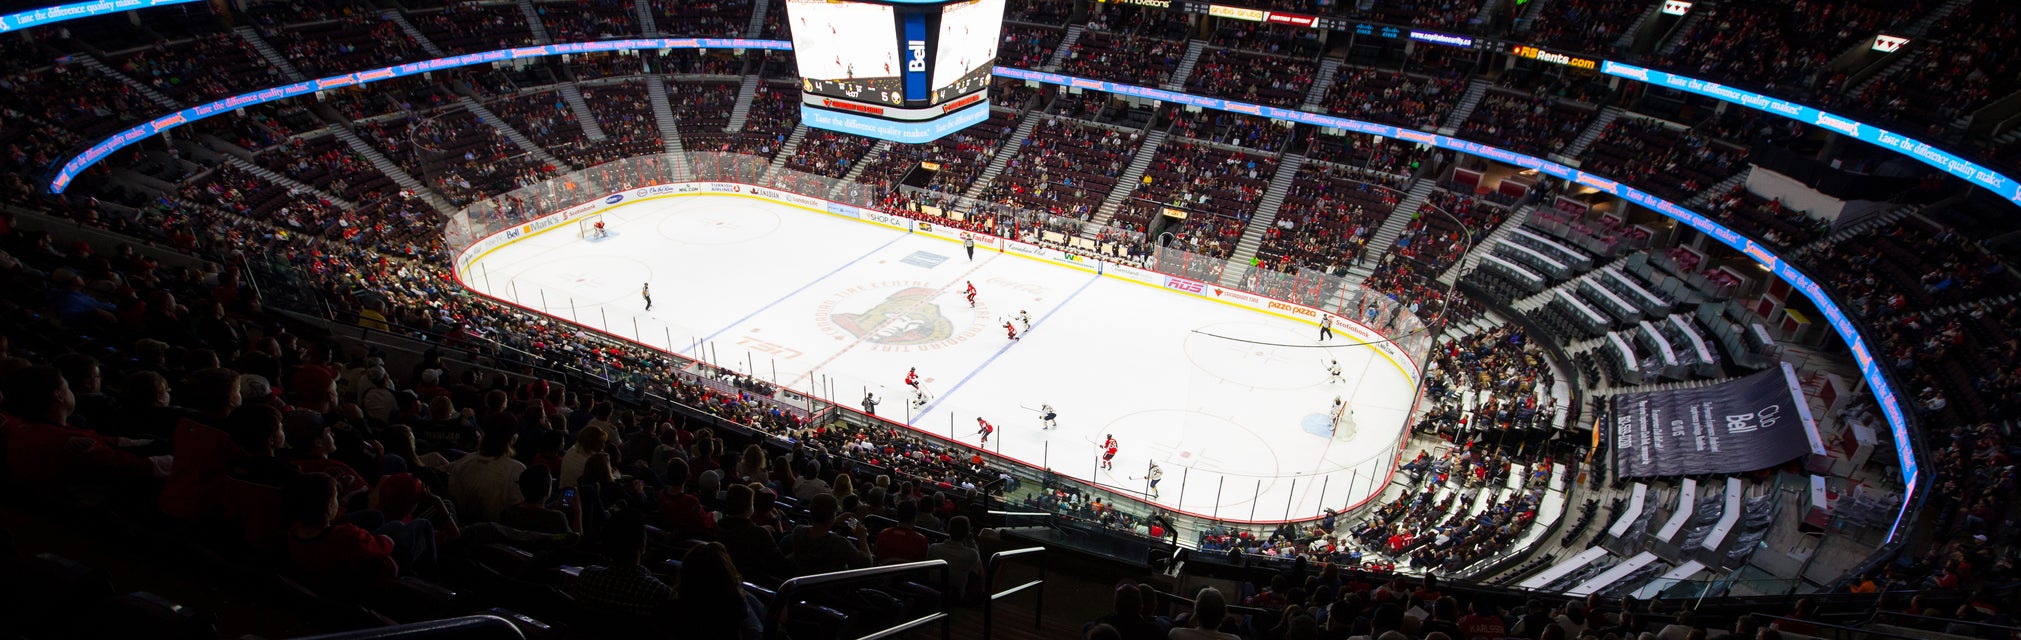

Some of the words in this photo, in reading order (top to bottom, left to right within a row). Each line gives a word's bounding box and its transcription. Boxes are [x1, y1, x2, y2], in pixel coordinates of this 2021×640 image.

[14, 13, 34, 25] Taste
[35, 10, 47, 21] the
[48, 6, 86, 19] difference
[1211, 7, 1234, 15] aruba
[1238, 9, 1261, 18] aruba
[908, 40, 926, 72] Bell
[815, 82, 822, 91] 4
[1140, 88, 1170, 99] difference
[1667, 73, 1687, 87] Taste
[1689, 79, 1702, 90] the
[1704, 82, 1740, 100] difference
[1741, 95, 1771, 109] quality
[213, 102, 225, 110] the
[225, 96, 258, 107] difference
[881, 92, 888, 101] 5
[814, 113, 831, 124] Taste
[831, 115, 843, 126] the
[844, 116, 876, 132] difference
[877, 121, 903, 137] quality
[1288, 110, 1300, 120] the
[1301, 113, 1336, 127] difference
[1466, 141, 1478, 152] the
[1480, 145, 1516, 161] difference
[1878, 129, 1900, 146] Taste
[1900, 137, 1914, 151] the
[1914, 142, 1948, 165] difference
[1948, 157, 1976, 178] quality
[1626, 187, 1644, 201] Taste
[1644, 194, 1657, 207] the
[1657, 201, 1692, 221] difference
[1692, 215, 1714, 233] quality
[529, 217, 559, 232] Mark's
[506, 228, 519, 240] Bell
[1268, 301, 1292, 312] pizza
[1292, 305, 1317, 317] pizza
[1335, 320, 1369, 338] Scotiabank
[1726, 413, 1758, 434] Bell
[1757, 404, 1781, 428] Club
